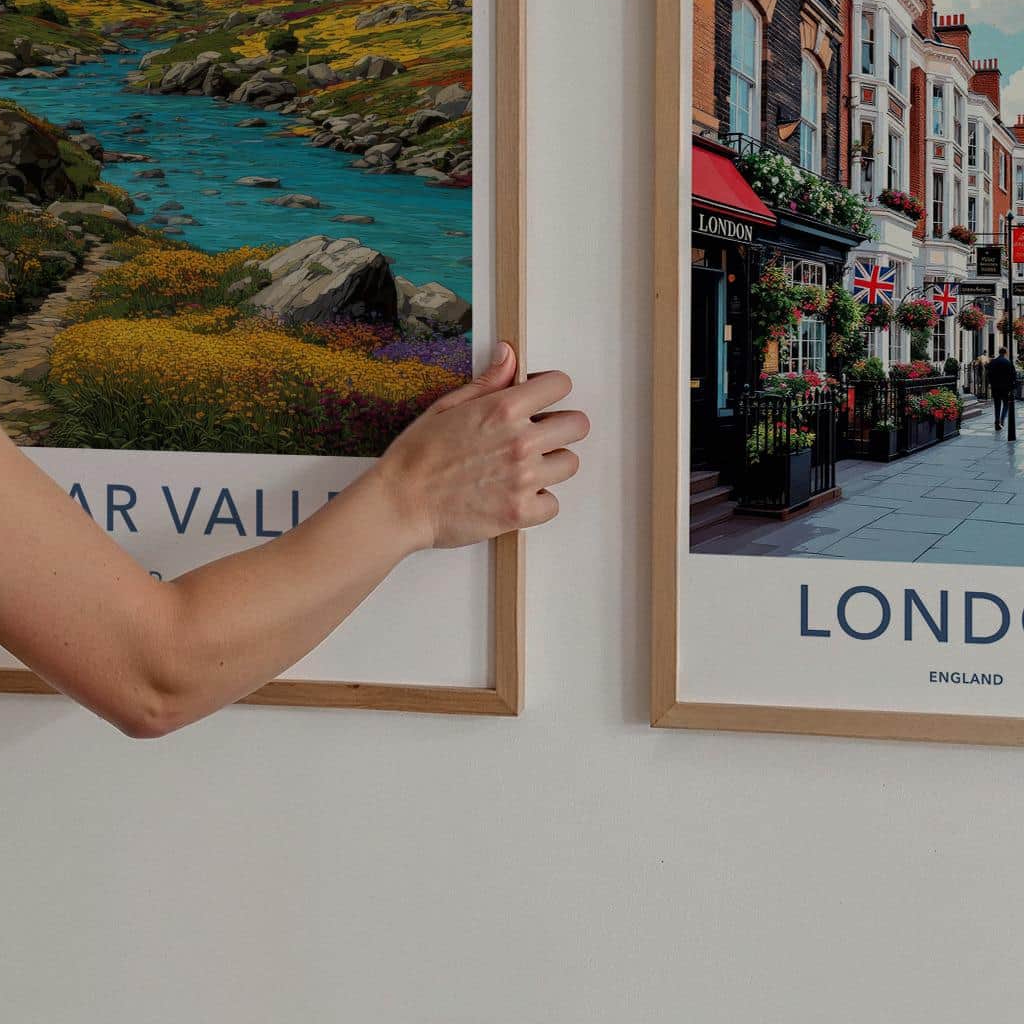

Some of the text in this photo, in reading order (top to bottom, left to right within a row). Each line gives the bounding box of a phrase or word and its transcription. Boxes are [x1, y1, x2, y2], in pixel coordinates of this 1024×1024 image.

[699, 213, 753, 242] LONDON
[161, 486, 342, 537] VALL
[800, 584, 1024, 644] LOND
[929, 670, 1004, 686] ENGLAND
